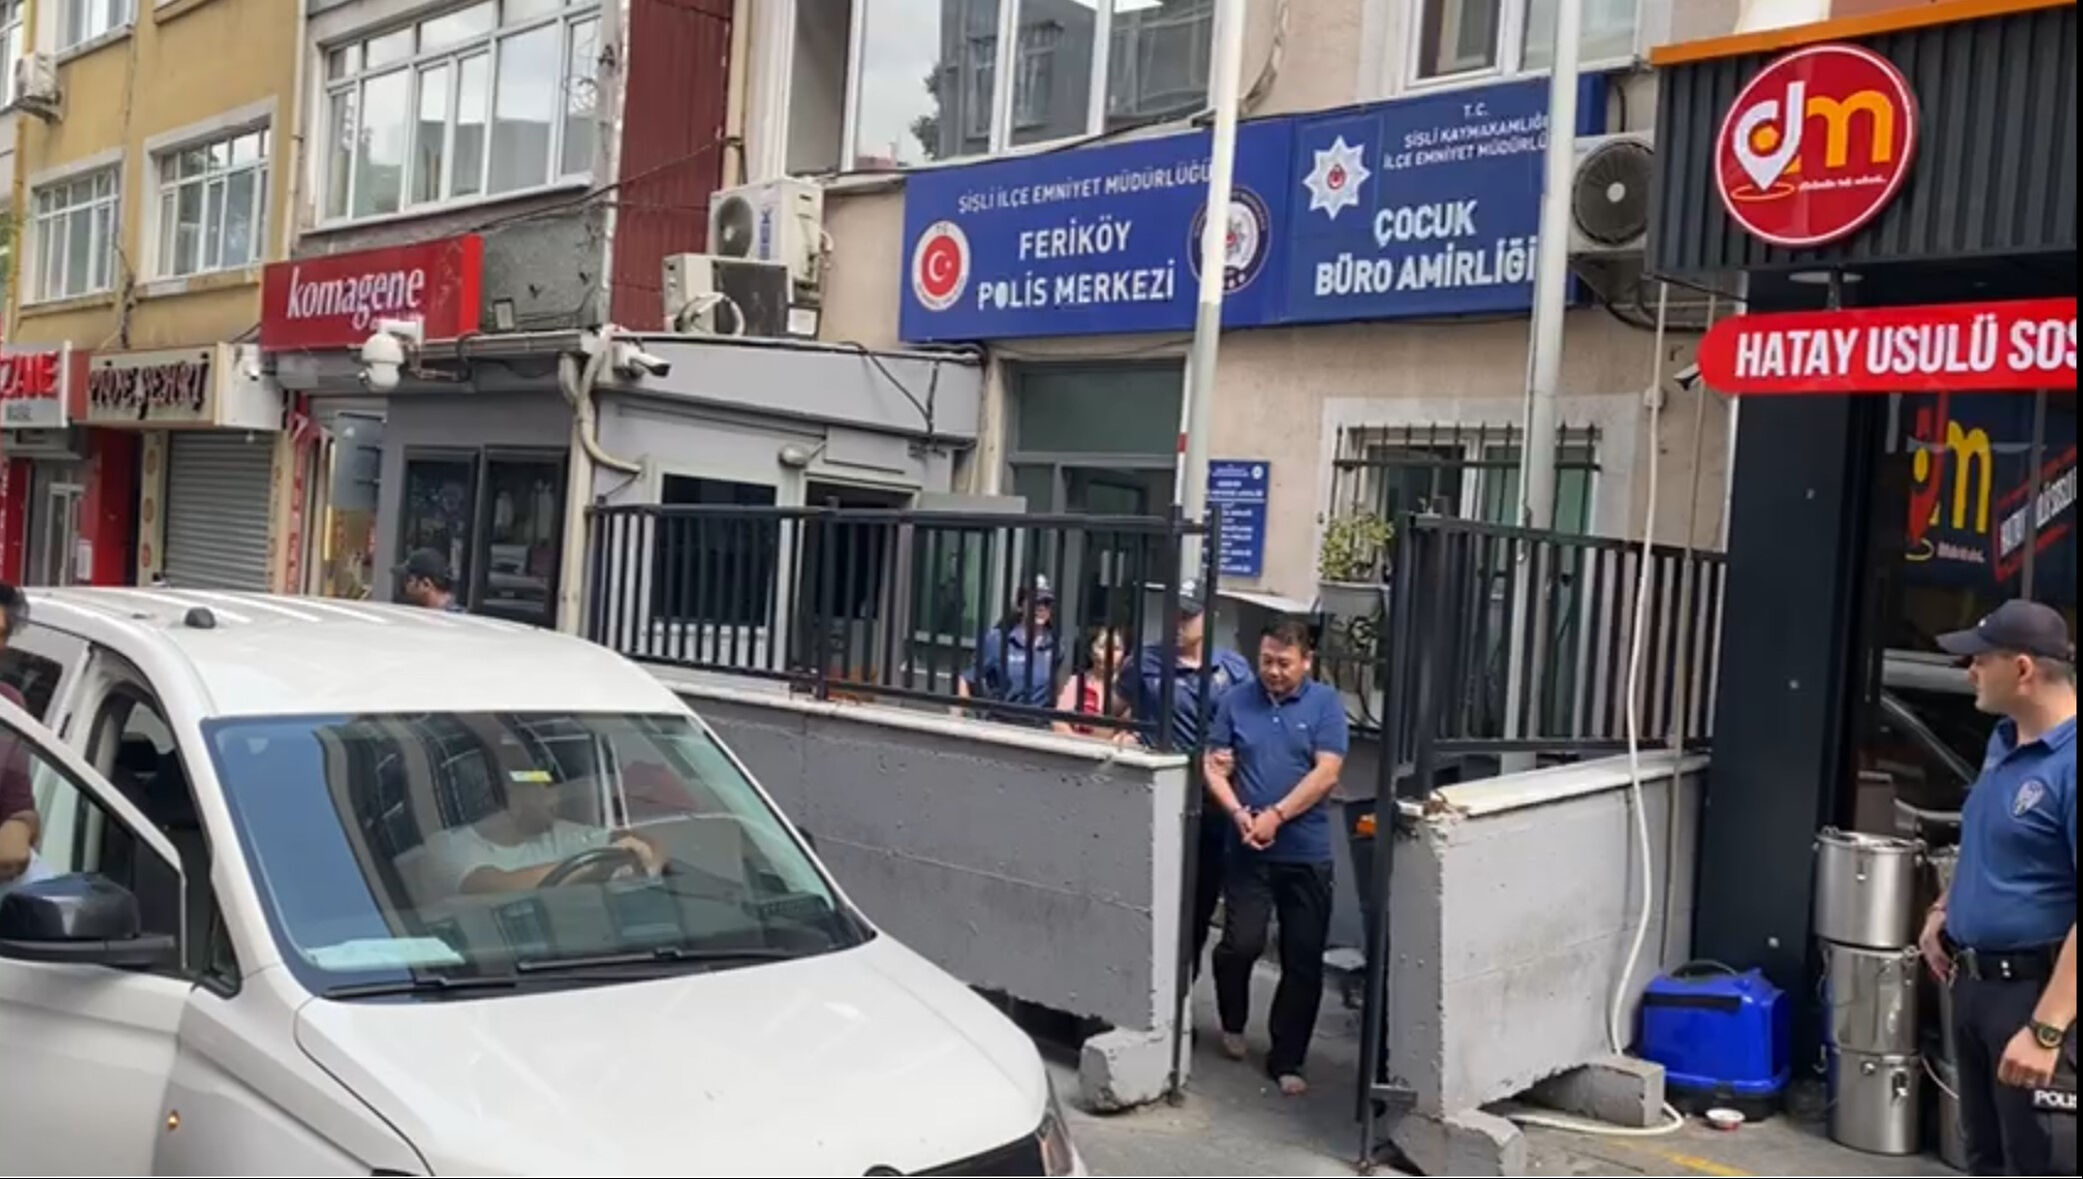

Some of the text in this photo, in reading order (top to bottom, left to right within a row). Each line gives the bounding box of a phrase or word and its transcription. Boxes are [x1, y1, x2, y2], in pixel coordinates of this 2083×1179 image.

[1463, 102, 1489, 118] T.C.
[1732, 80, 1894, 192] dm
[1477, 130, 1549, 158] MÜDÜRLÜ
[997, 184, 1029, 209] İLÇE
[1032, 176, 1102, 204] EMNİYET
[1105, 156, 1212, 195] MÜDÜRLÜĞÜ
[1019, 214, 1132, 261] FERİKÖY
[1374, 200, 1477, 249] ÇOCUK
[978, 270, 1049, 311] POLİS
[1054, 258, 1176, 305] MERKEZİ
[1314, 235, 1538, 296] BÜRO AMİRLİĞİ
[287, 265, 425, 331] komagene
[1735, 327, 1860, 378] HATAY
[1865, 313, 1999, 375] USULÜ
